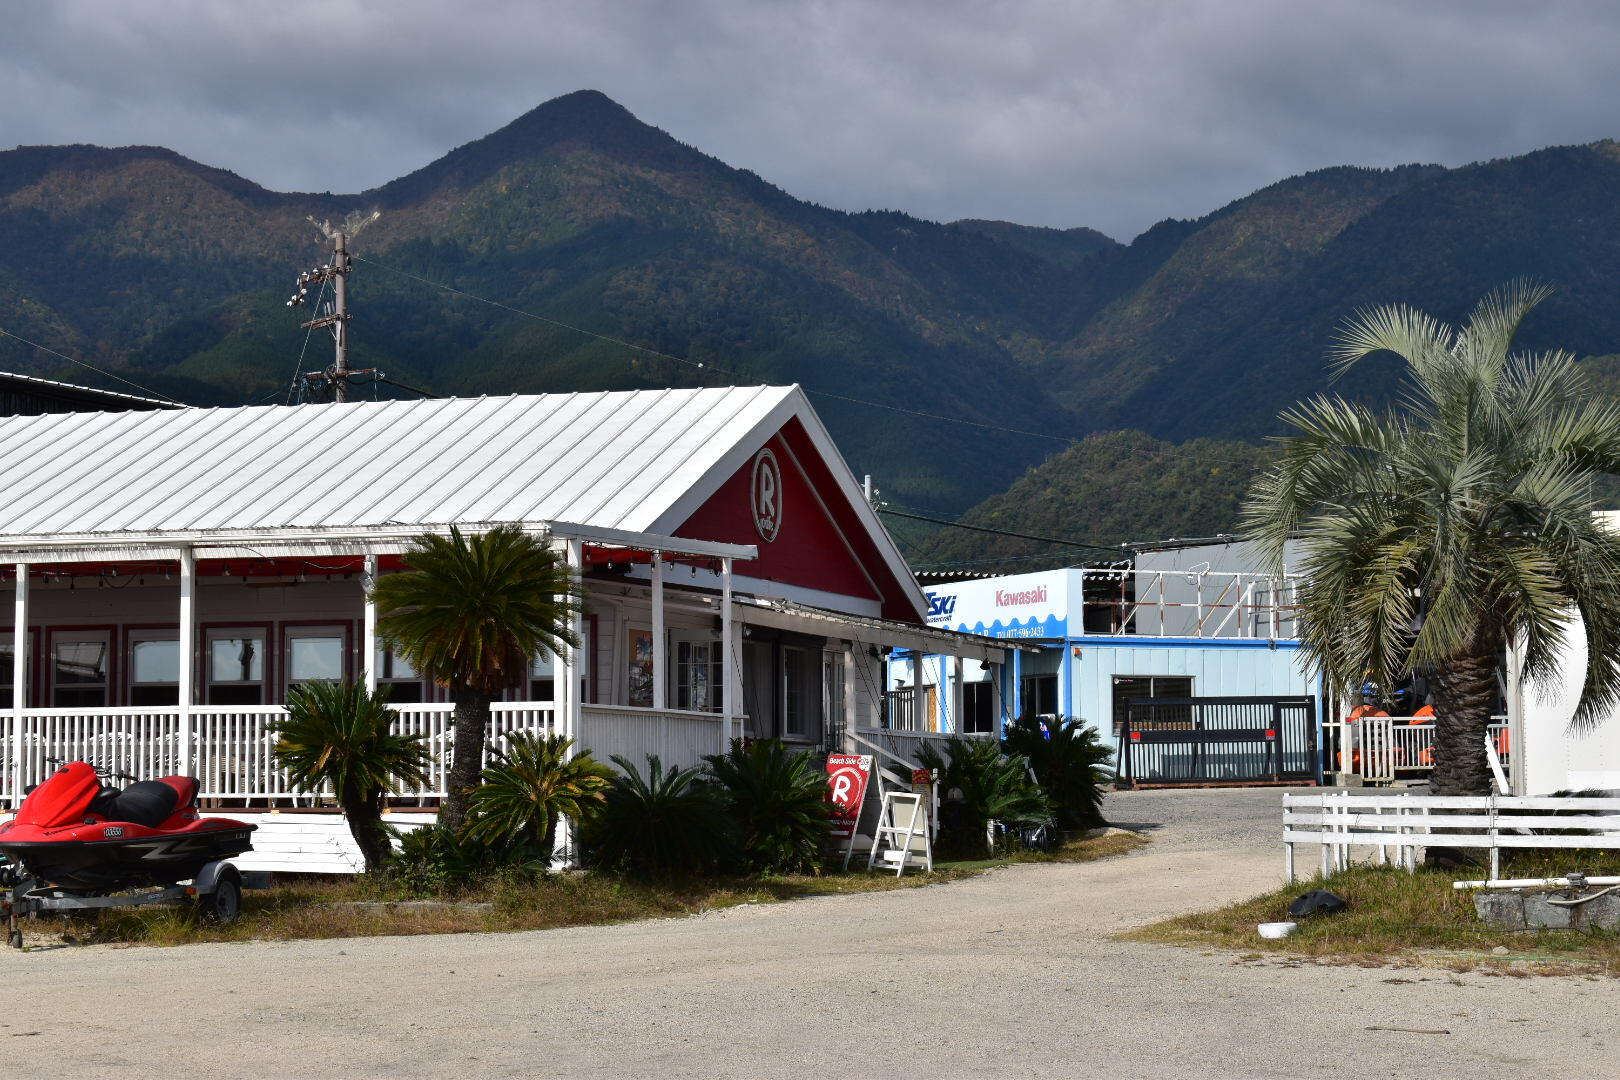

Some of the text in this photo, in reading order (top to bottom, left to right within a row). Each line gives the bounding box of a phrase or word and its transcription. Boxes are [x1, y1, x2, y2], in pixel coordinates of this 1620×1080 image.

[760, 463, 775, 517] R
[996, 585, 1047, 607] Kawasaki
[832, 775, 850, 802] R
